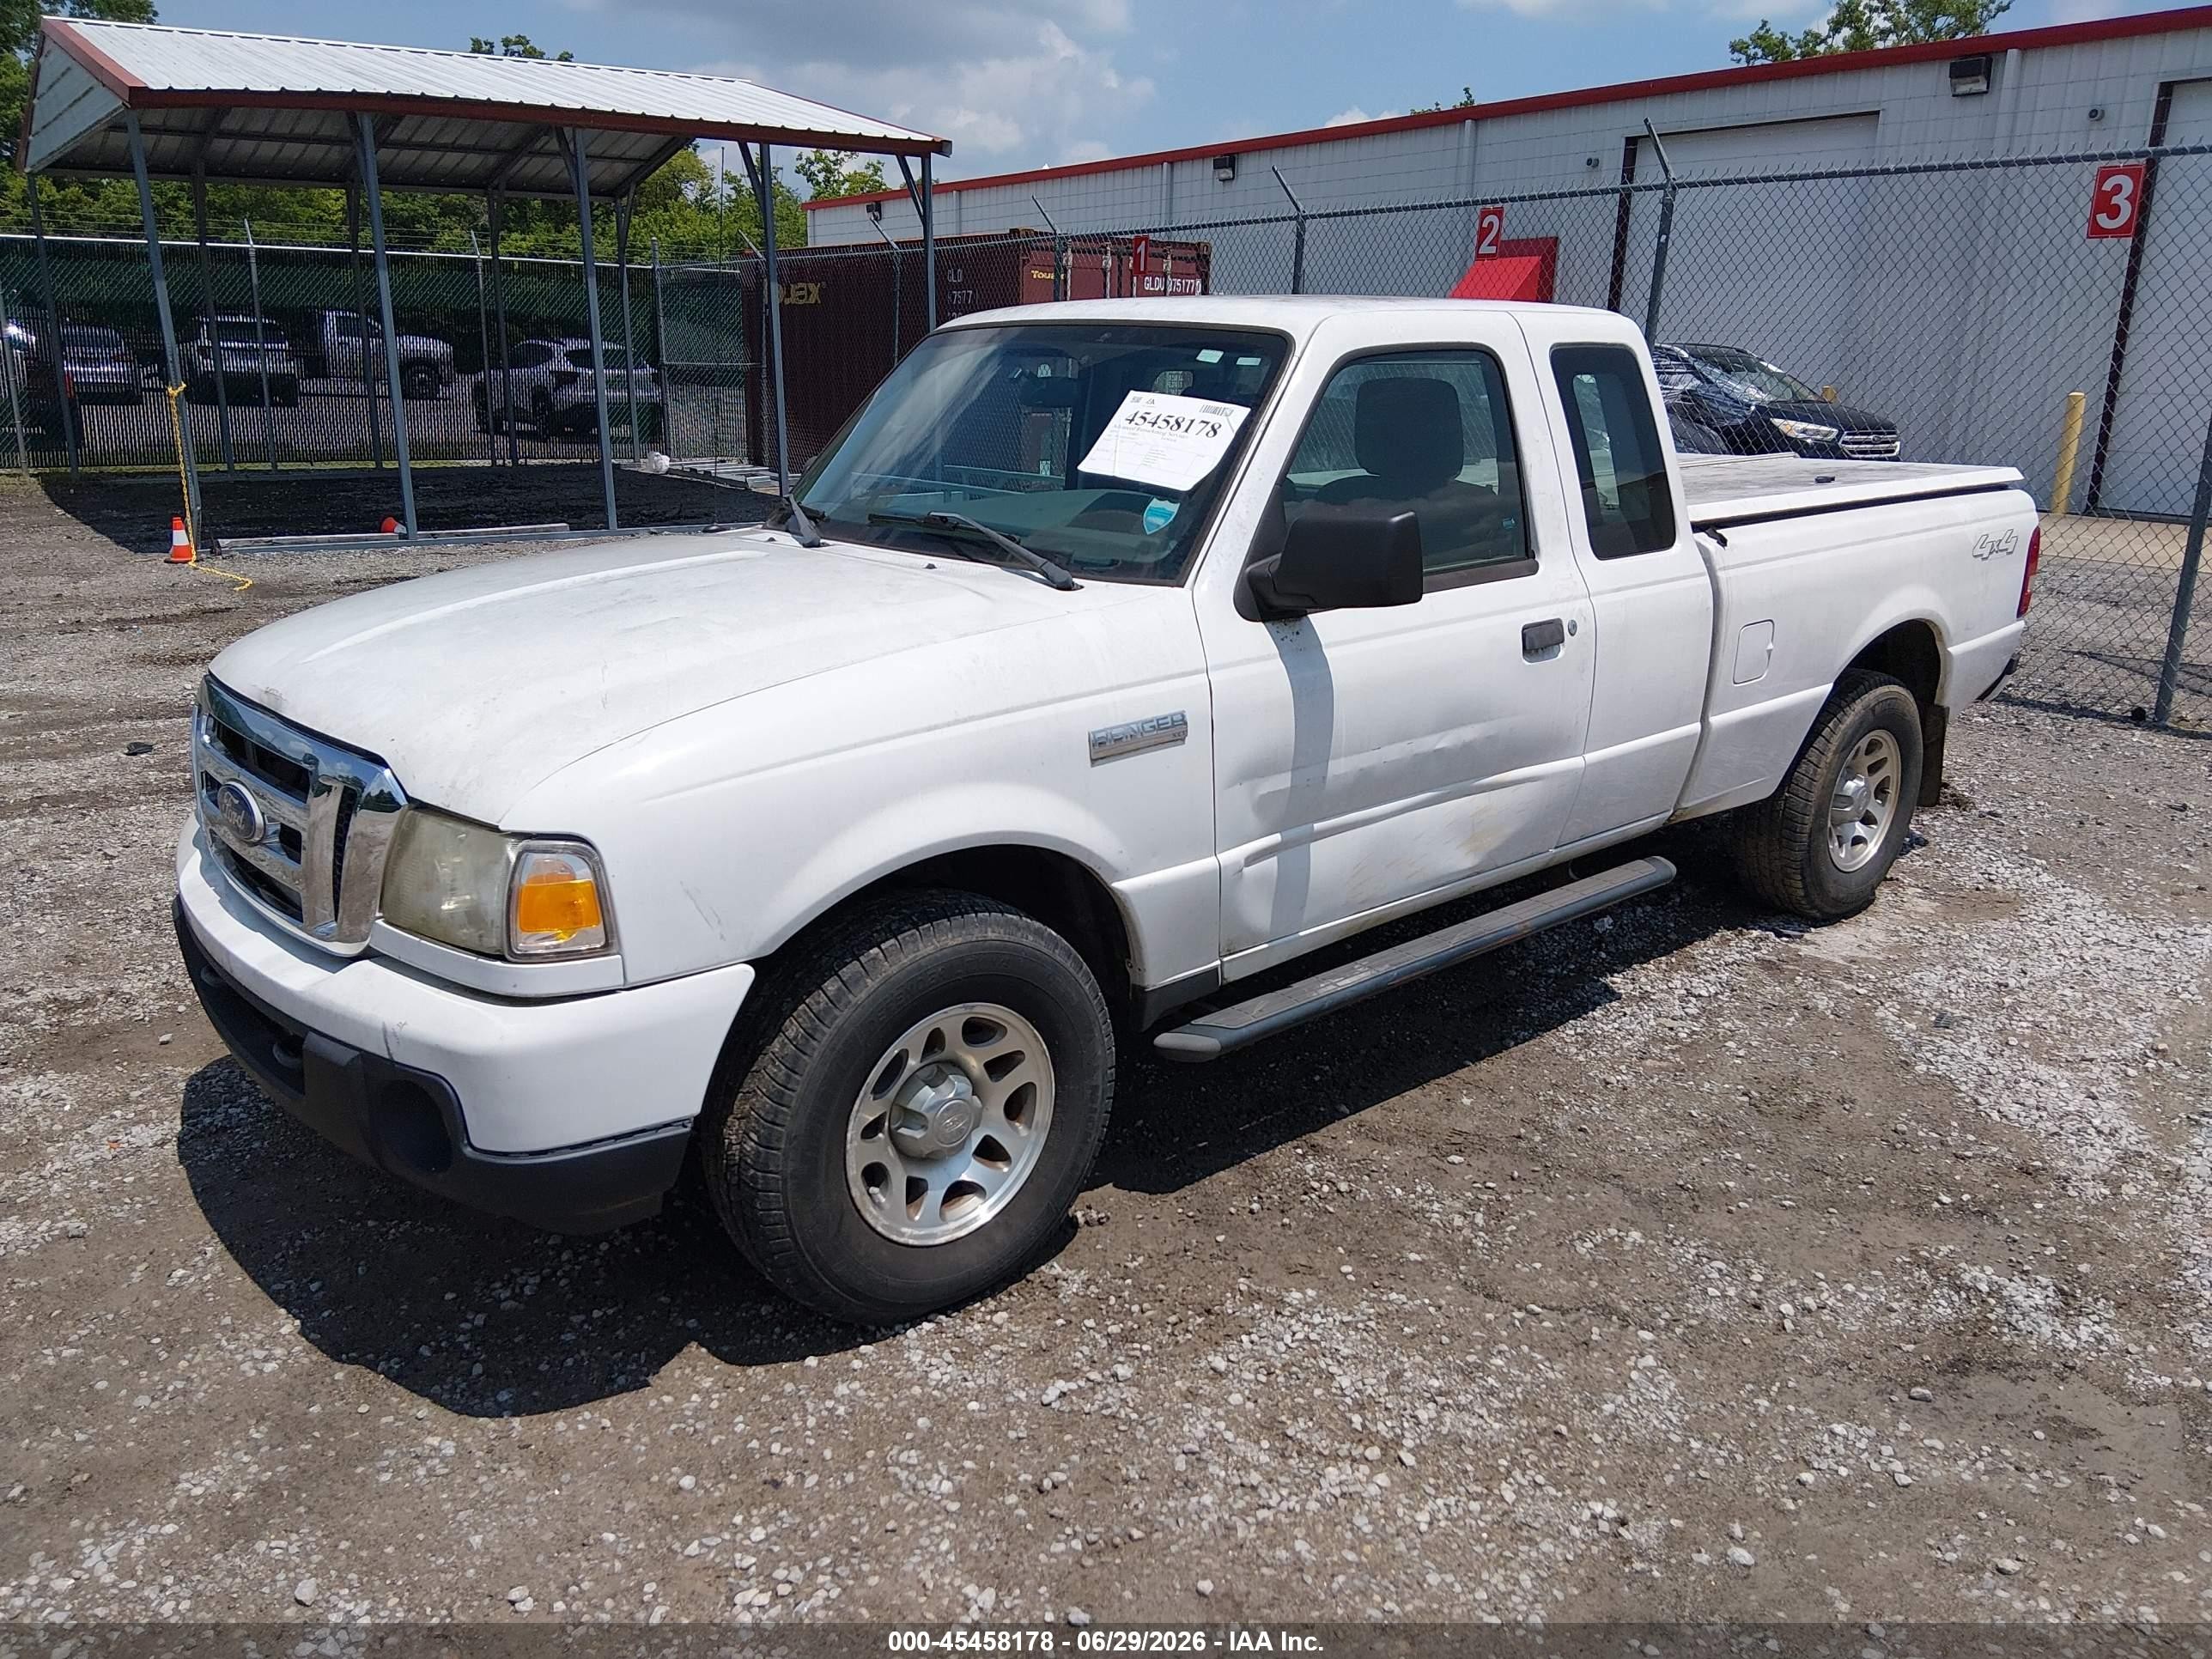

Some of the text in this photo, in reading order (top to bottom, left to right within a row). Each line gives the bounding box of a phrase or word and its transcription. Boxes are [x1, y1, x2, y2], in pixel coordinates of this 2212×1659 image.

[2096, 174, 2134, 229] 3
[1478, 214, 1500, 254] 2
[1136, 240, 1146, 271] 1
[1144, 276, 1165, 291] GLDU
[1125, 410, 1222, 439] 45458178
[1972, 528, 2019, 562] 4x4
[1092, 713, 1186, 749] RANGER
[223, 791, 246, 830] Ford
